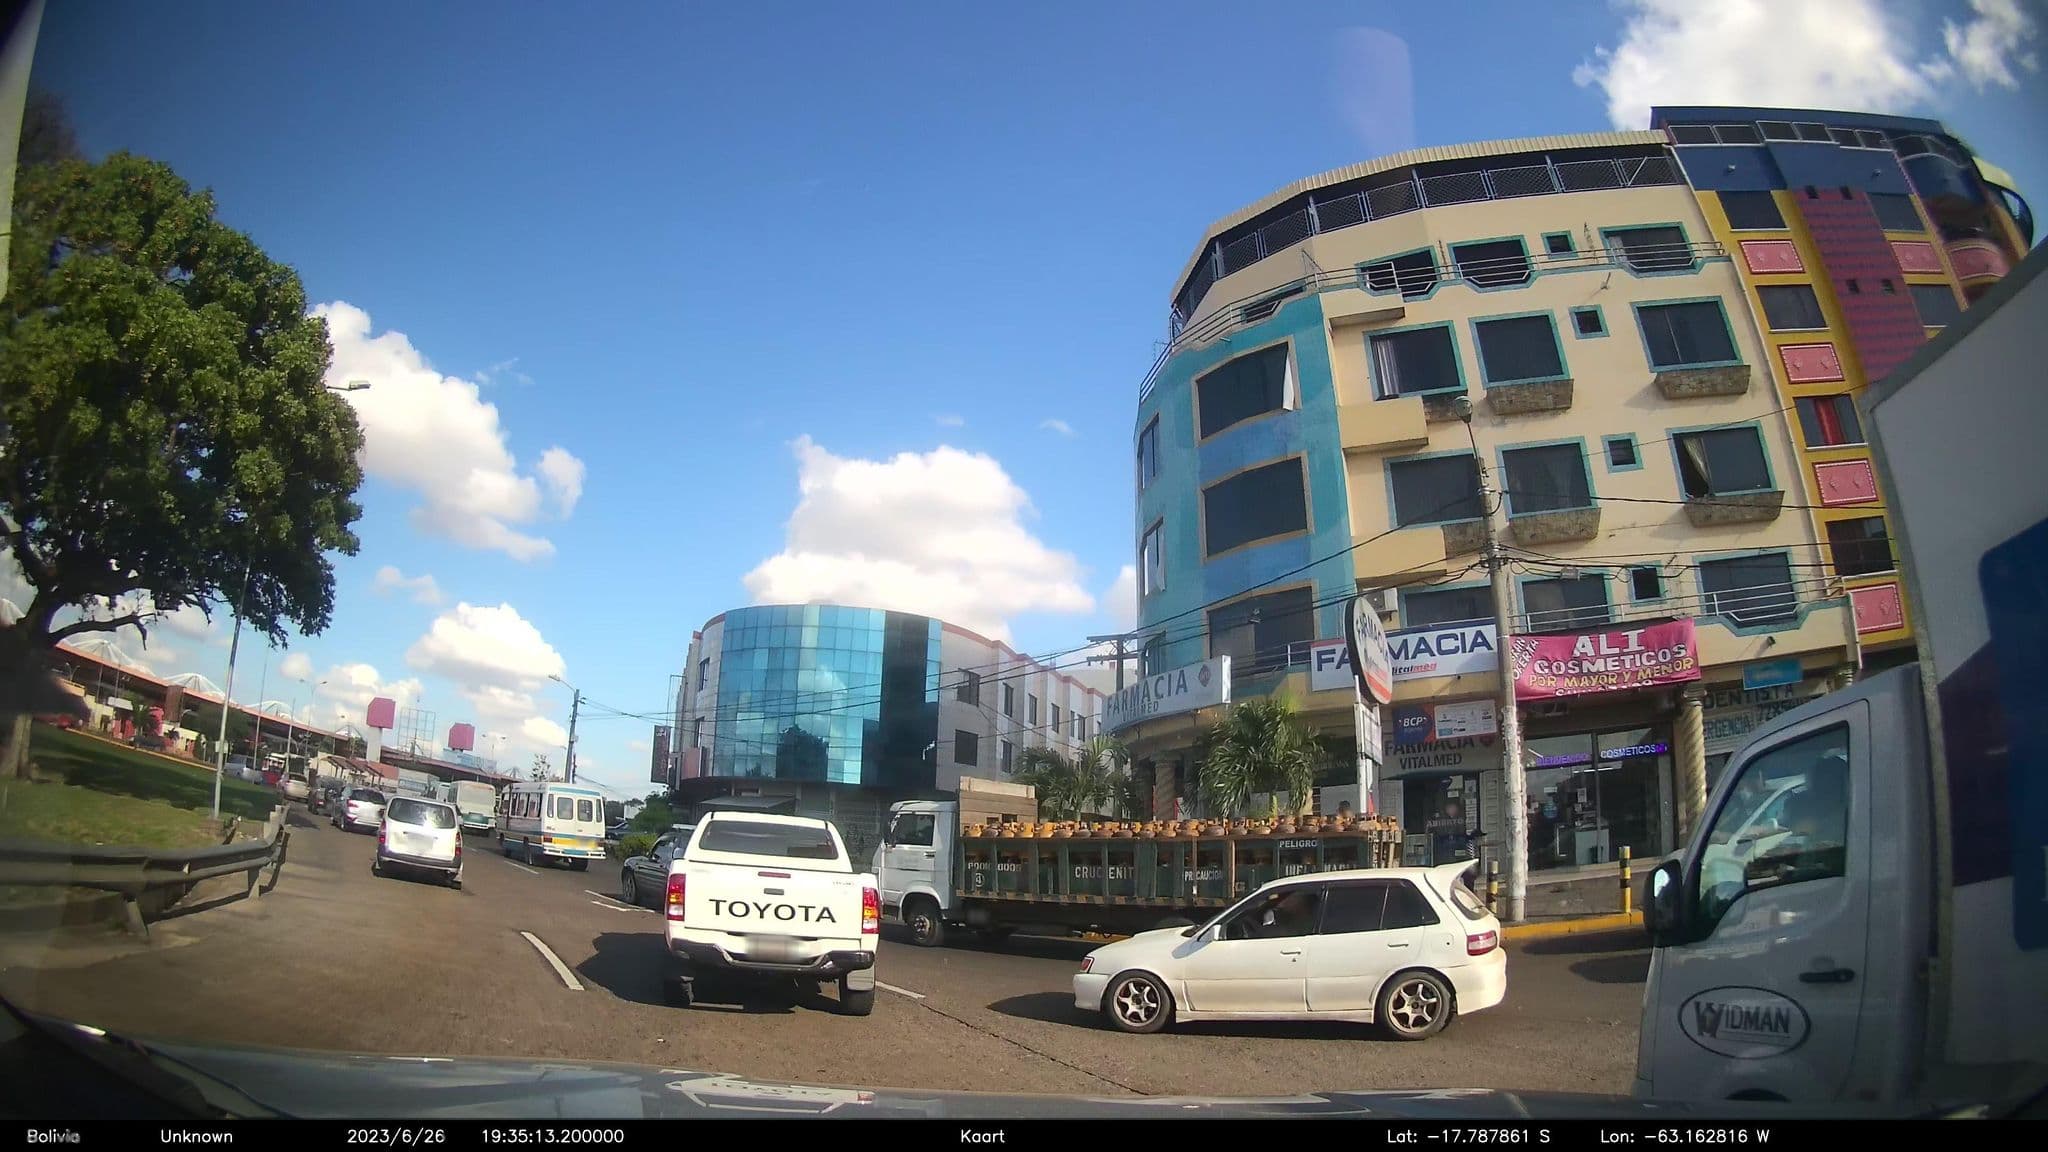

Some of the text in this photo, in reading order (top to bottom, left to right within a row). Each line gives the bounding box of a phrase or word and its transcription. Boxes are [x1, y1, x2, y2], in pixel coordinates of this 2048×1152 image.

[1316, 629, 1494, 672] FAMACIA
[1573, 629, 1647, 658] ALI
[1512, 639, 1540, 681] OFERTA
[1529, 656, 1694, 688] POR MAYOR Y MENOR
[1533, 643, 1688, 676] COSMETICOS
[1106, 669, 1188, 717] FARMACIA
[1403, 716, 1424, 728] BCP
[1400, 753, 1463, 770] VITALMED
[1600, 744, 1656, 759] COSMETICOS
[1279, 839, 1318, 849] PELIGRO
[708, 898, 837, 924] TOYOTA
[1694, 1000, 1791, 1039] WIDMAN
